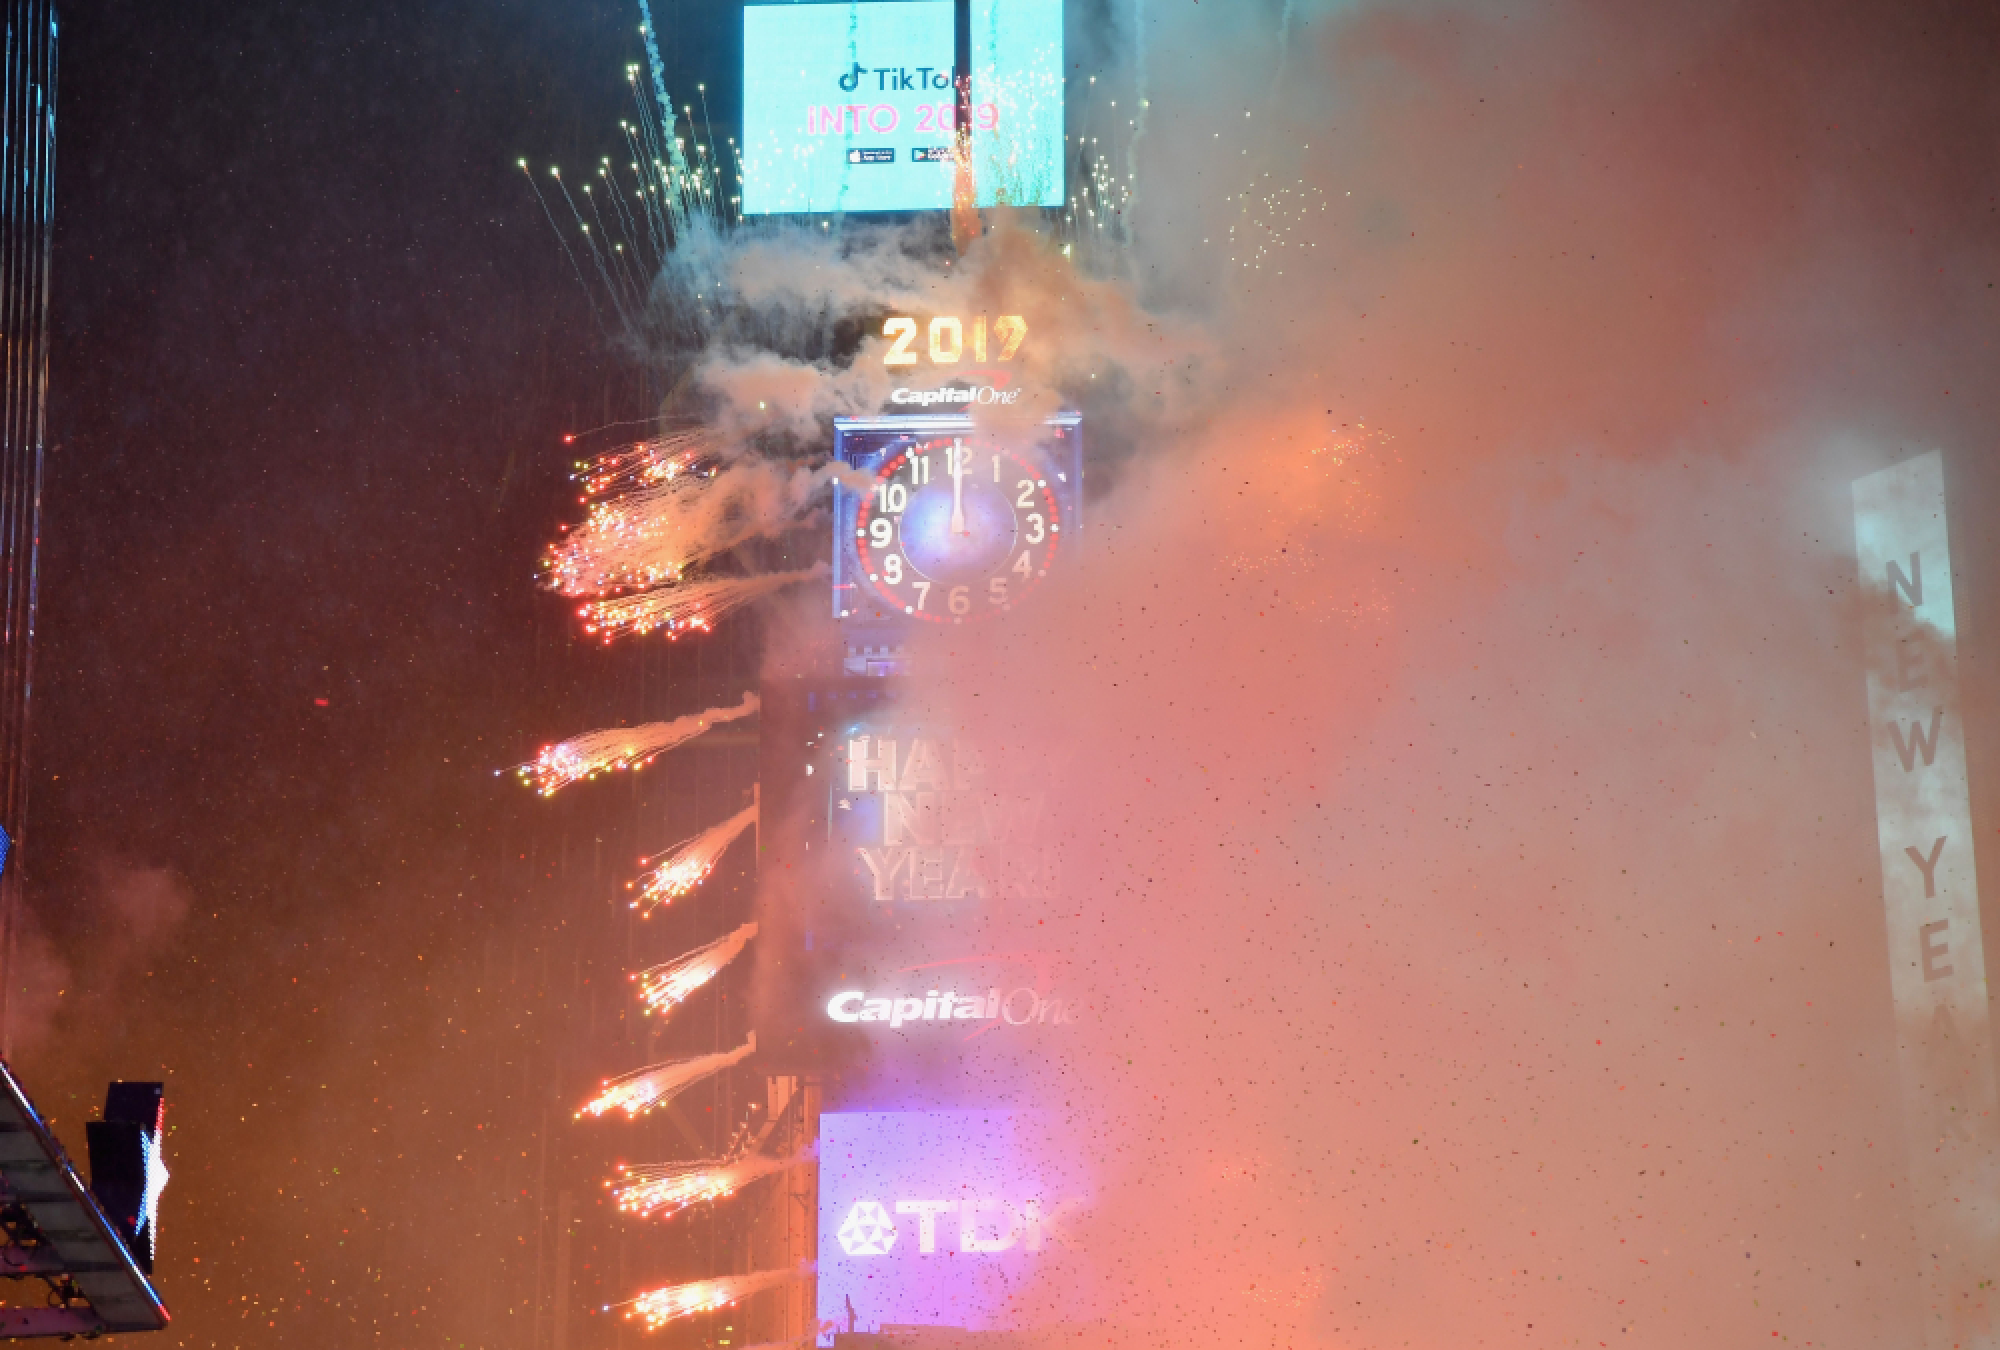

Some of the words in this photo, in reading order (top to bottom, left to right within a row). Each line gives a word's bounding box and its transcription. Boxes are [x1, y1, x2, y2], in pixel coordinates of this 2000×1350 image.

[807, 104, 899, 135] INTO
[913, 103, 999, 133] 209
[883, 315, 1028, 365] 2019
[910, 455, 930, 485] 11
[879, 483, 907, 513] 10
[1015, 479, 1035, 508] 2
[869, 518, 893, 548] 9
[1025, 512, 1045, 544] 3
[883, 554, 903, 585] 8
[1011, 549, 1033, 581] 4
[911, 581, 931, 610] 7
[948, 585, 971, 615] 6
[987, 577, 1009, 604] 5
